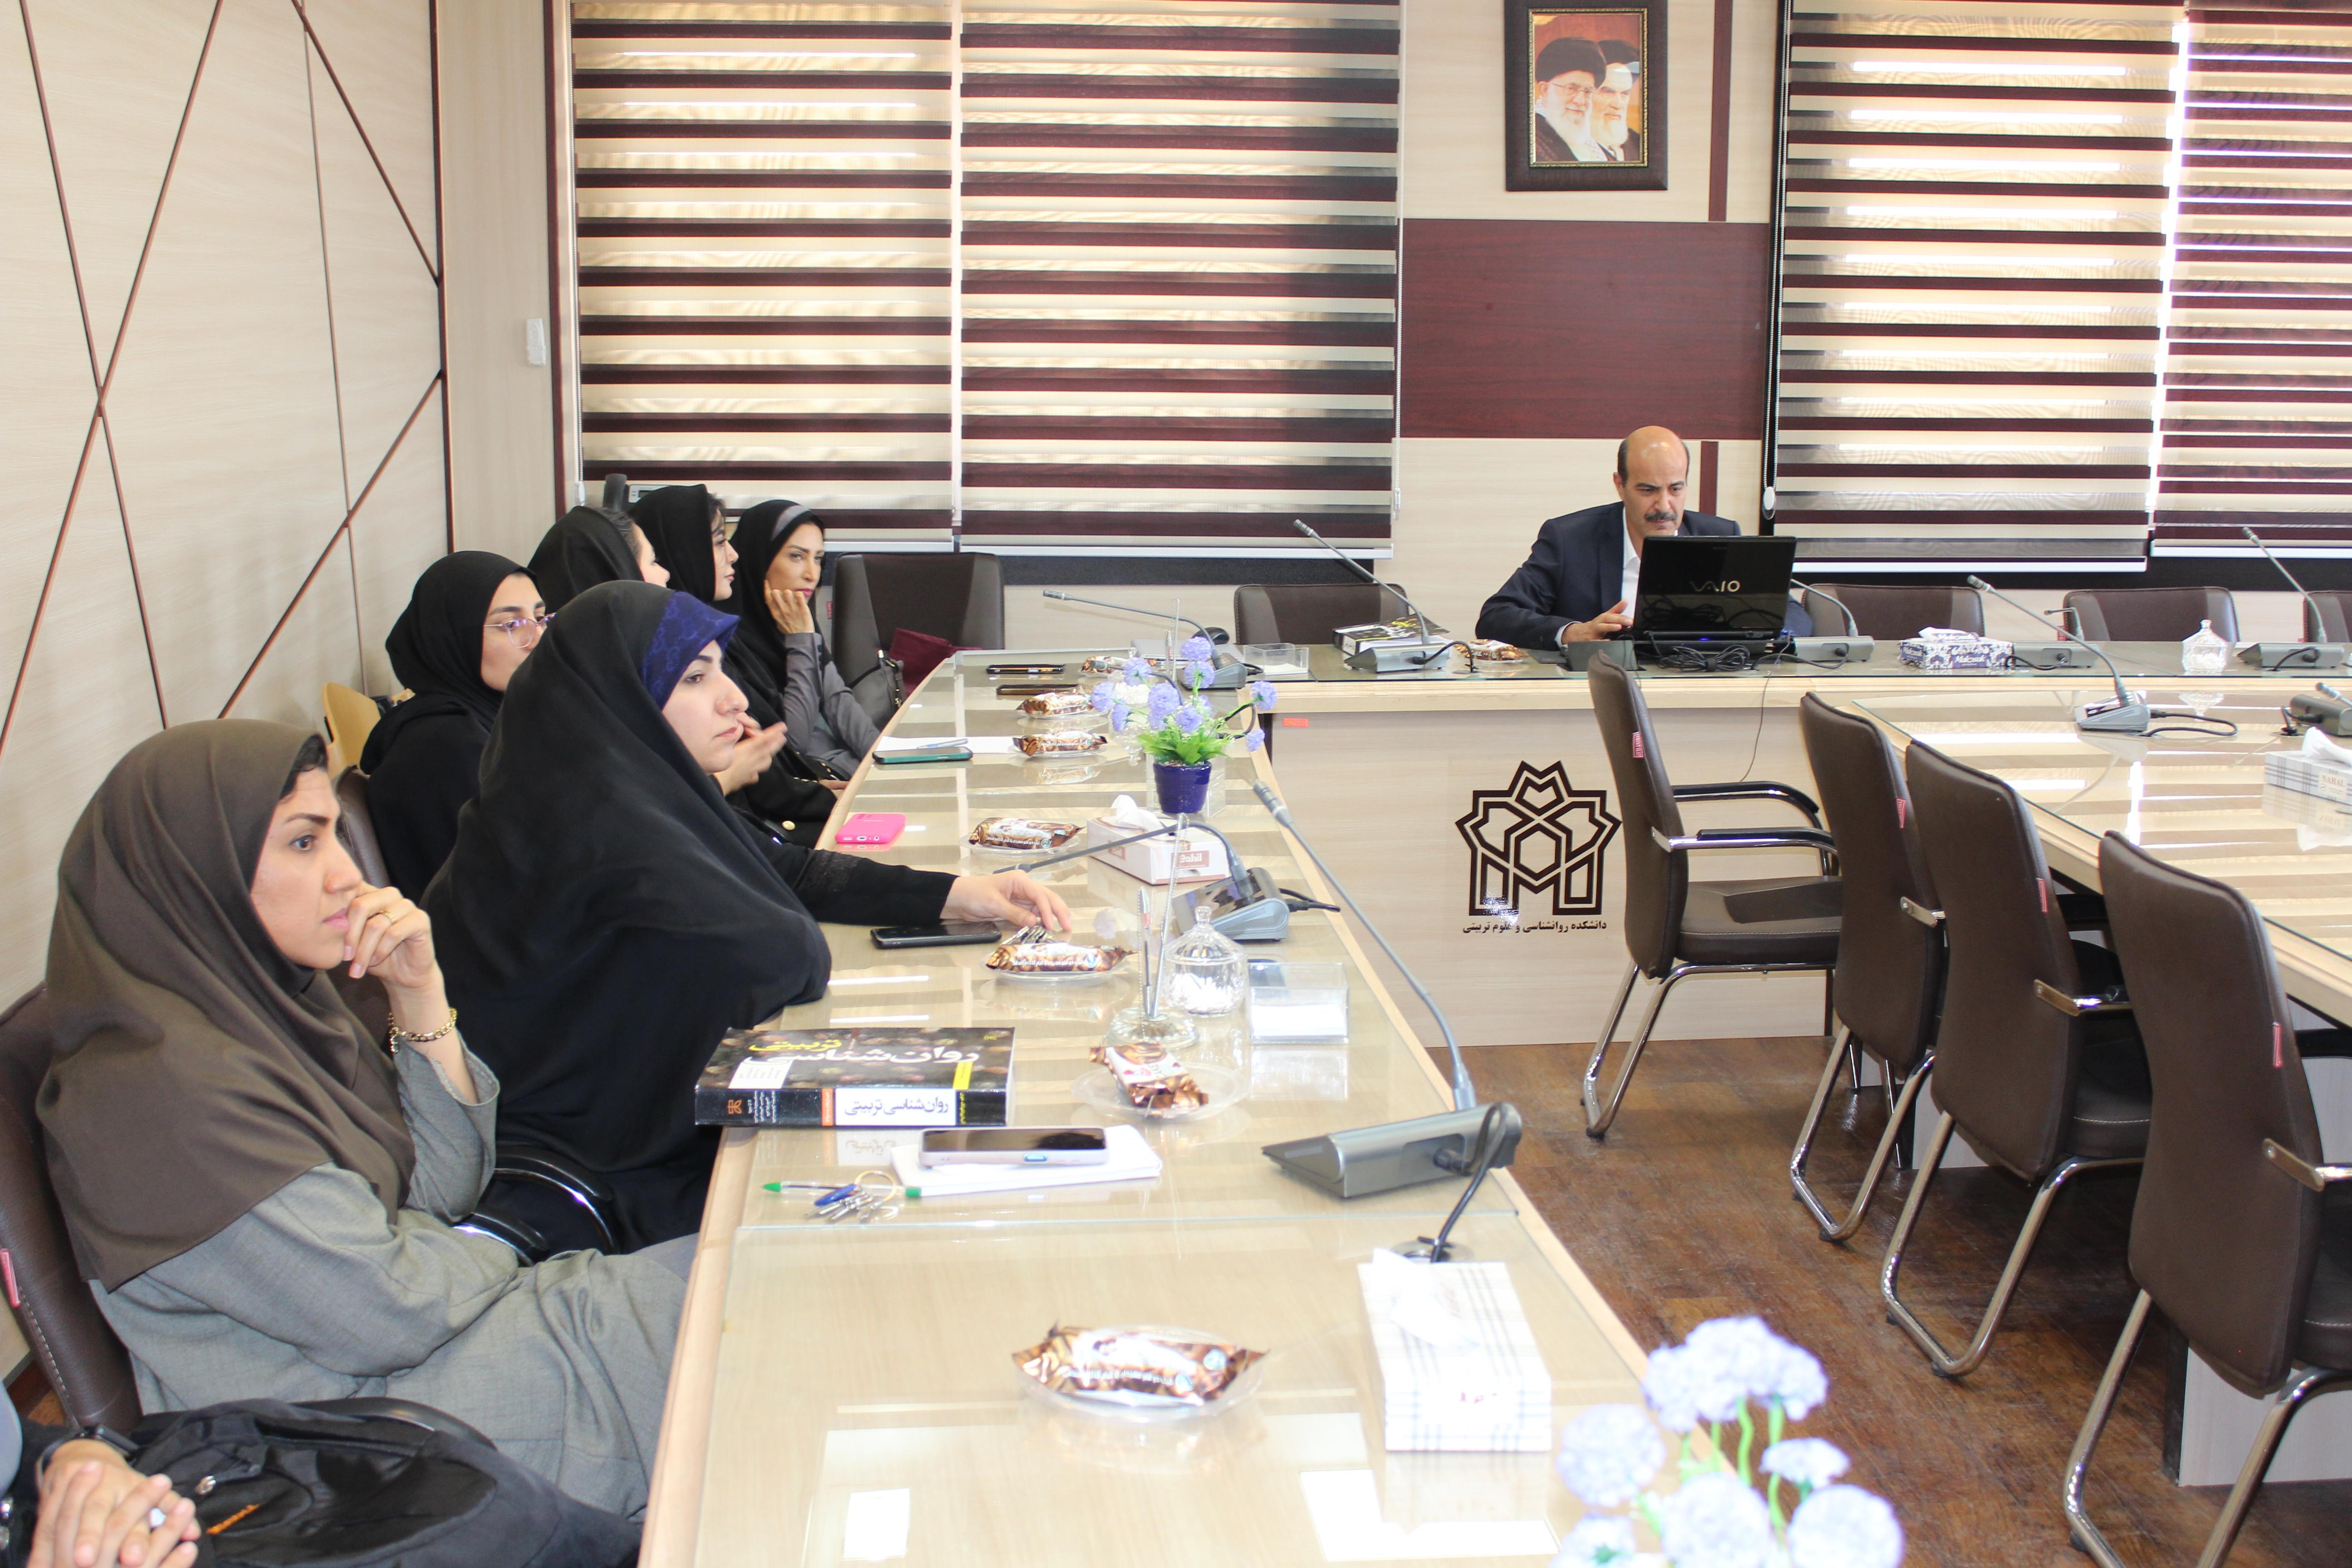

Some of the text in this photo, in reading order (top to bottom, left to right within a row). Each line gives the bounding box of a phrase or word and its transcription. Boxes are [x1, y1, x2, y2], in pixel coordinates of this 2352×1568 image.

[1689, 580, 1740, 592] VAIO
[2322, 775, 2346, 788] NAHAL
[1179, 853, 1202, 864] Rahil
[1463, 921, 1491, 934] تربیتی
[1523, 921, 1568, 934] روانشناسی
[1572, 920, 1607, 931] دانشکده
[748, 1039, 843, 1052] تربیتی
[844, 1098, 883, 1116] تربیتی
